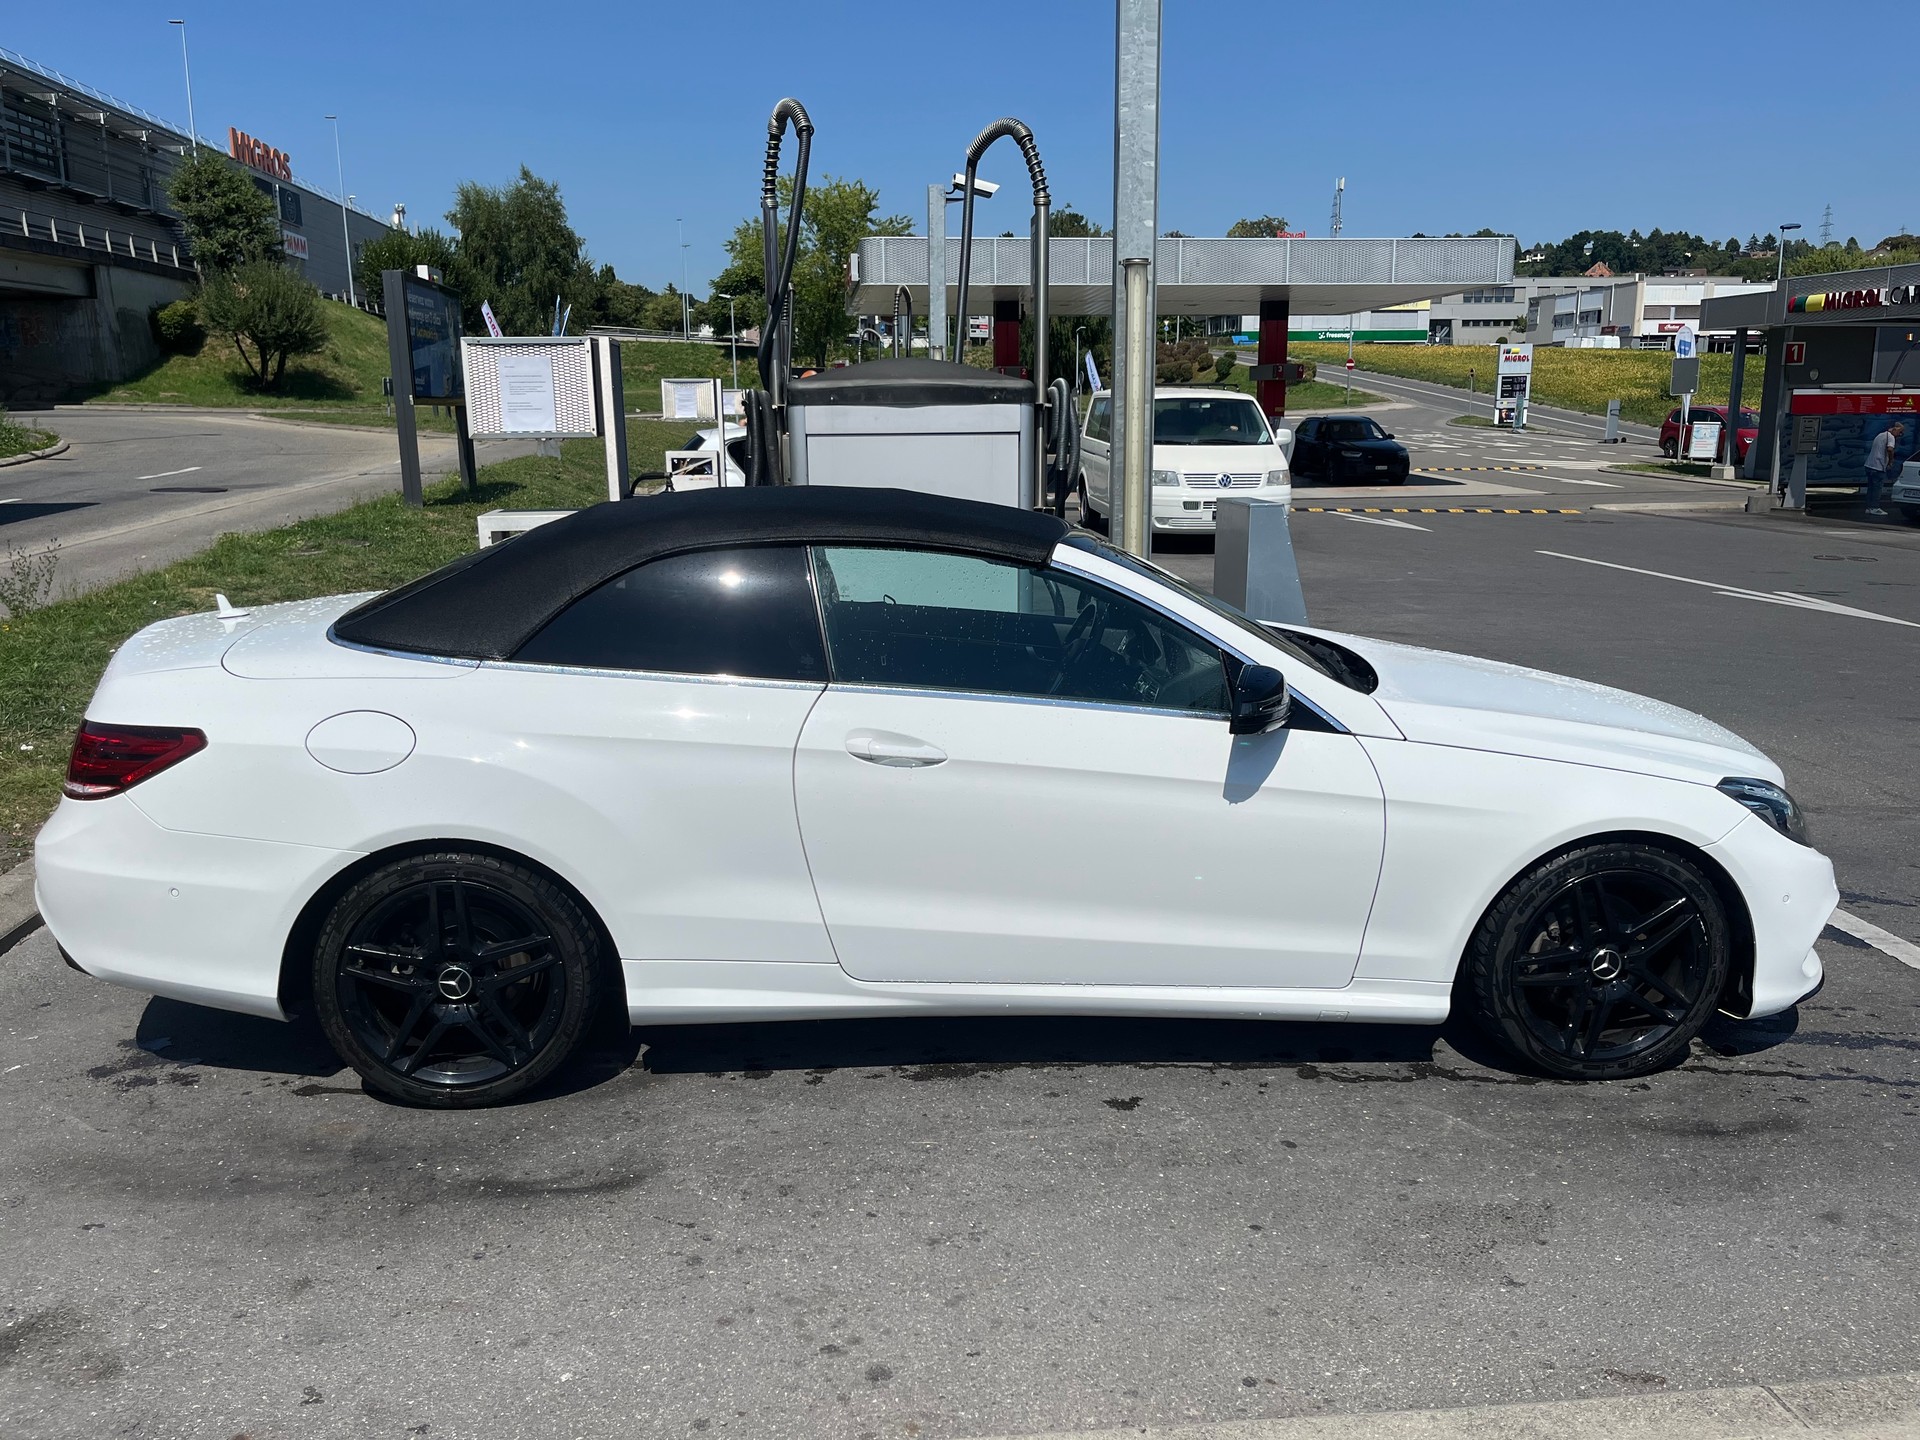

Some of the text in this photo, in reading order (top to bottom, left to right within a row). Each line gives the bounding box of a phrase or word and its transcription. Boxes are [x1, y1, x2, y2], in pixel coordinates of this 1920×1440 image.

[229, 127, 292, 182] MIGROS
[1823, 287, 1889, 312] MIGROL
[1503, 355, 1530, 363] MIGROL
[1791, 344, 1799, 362] 1
